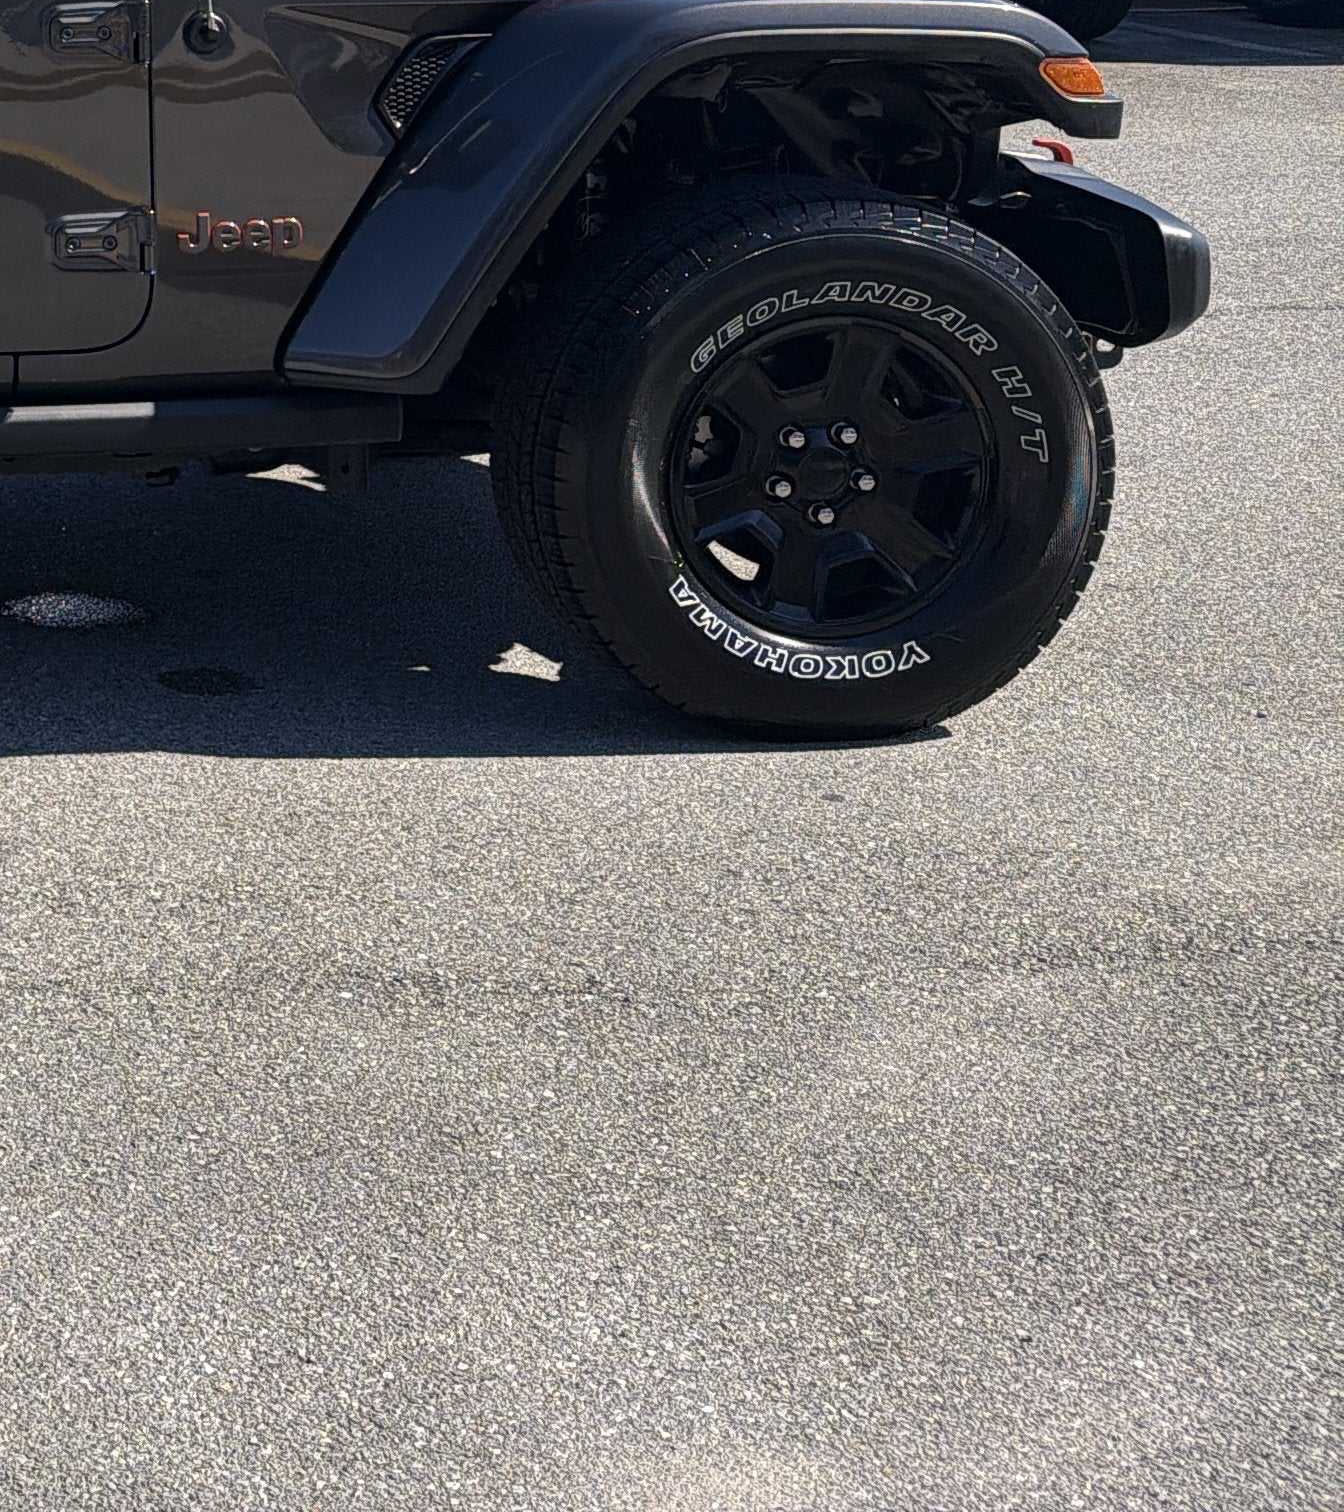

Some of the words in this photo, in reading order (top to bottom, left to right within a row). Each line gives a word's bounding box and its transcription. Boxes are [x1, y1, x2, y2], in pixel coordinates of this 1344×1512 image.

[177, 210, 304, 258] Jeep
[690, 281, 999, 373] GEOLANDAR
[992, 365, 1049, 463] H/T
[668, 573, 931, 680] YOKOHAMA
